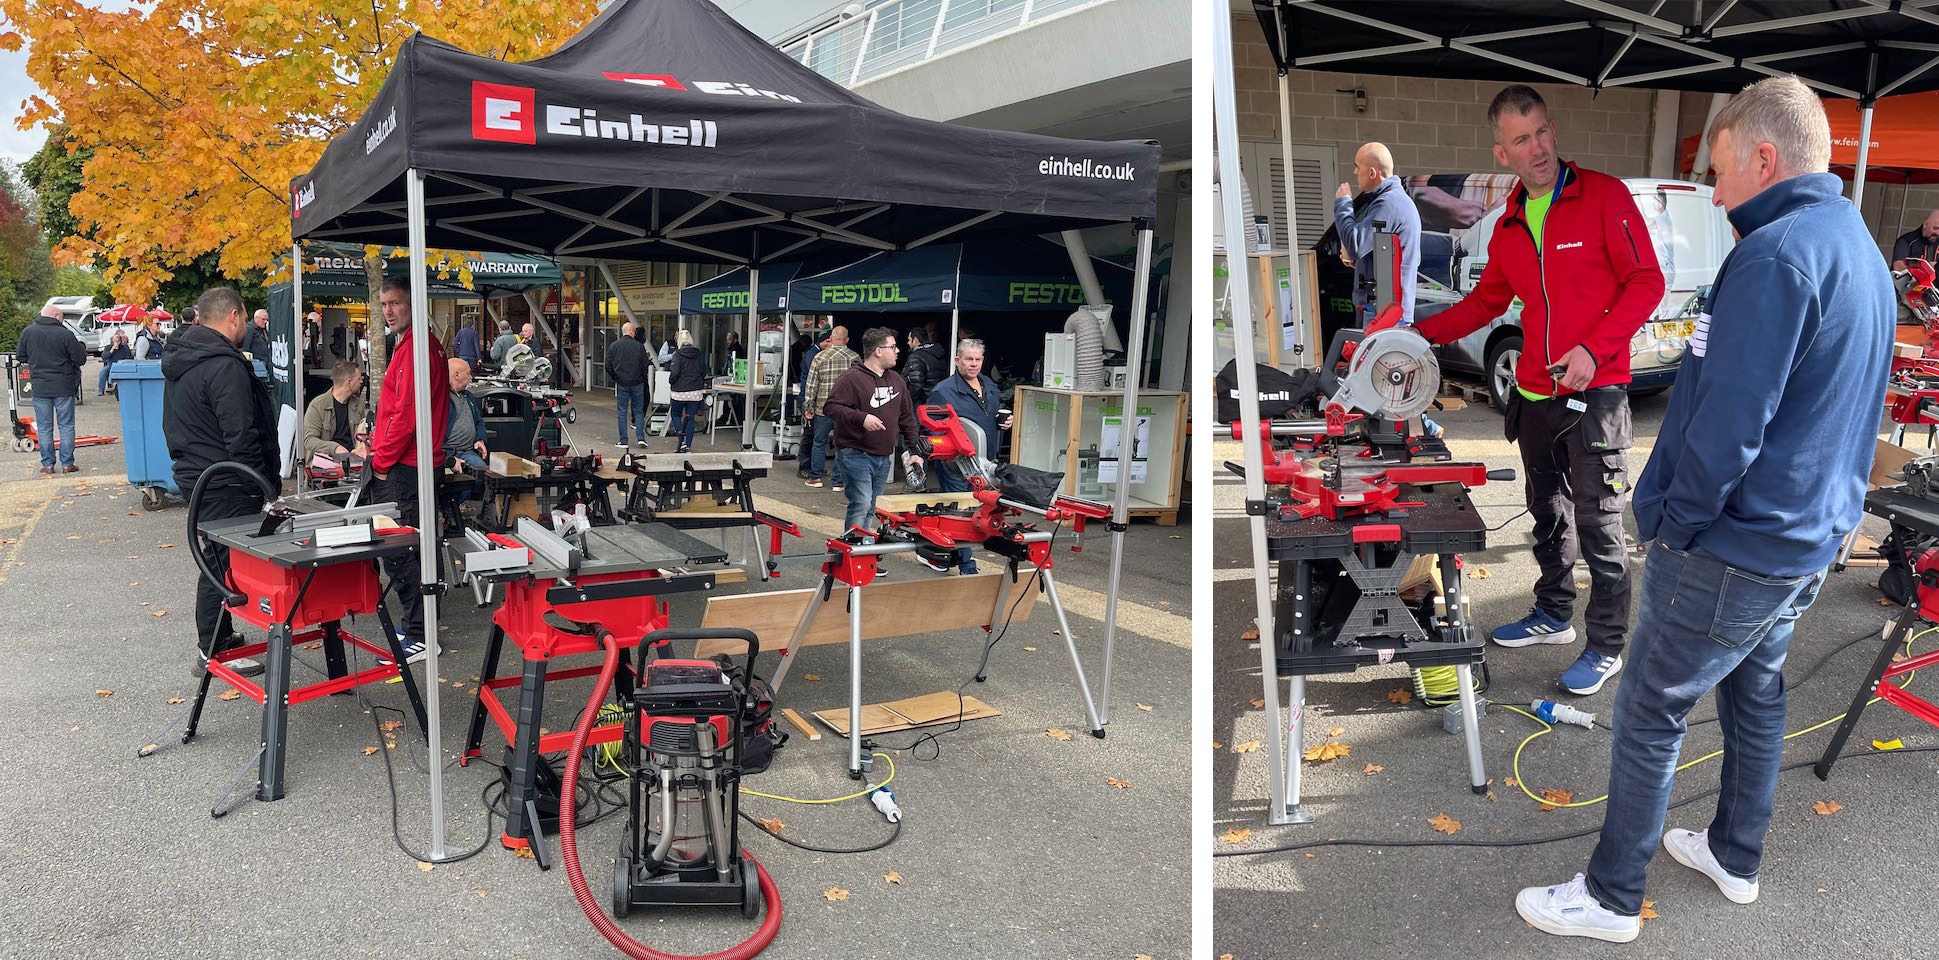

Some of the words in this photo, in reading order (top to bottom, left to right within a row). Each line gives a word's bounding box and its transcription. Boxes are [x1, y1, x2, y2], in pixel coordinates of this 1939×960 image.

[546, 104, 718, 148] Einhell
[1039, 155, 1135, 181] einhell.co.uk
[1556, 241, 1583, 250] Einhell
[467, 261, 539, 274] WARRANTY
[701, 291, 751, 309] FESTOO
[821, 282, 909, 304] FESTOOL
[1008, 282, 1113, 304] FESTO
[1229, 388, 1290, 401] Ehell
